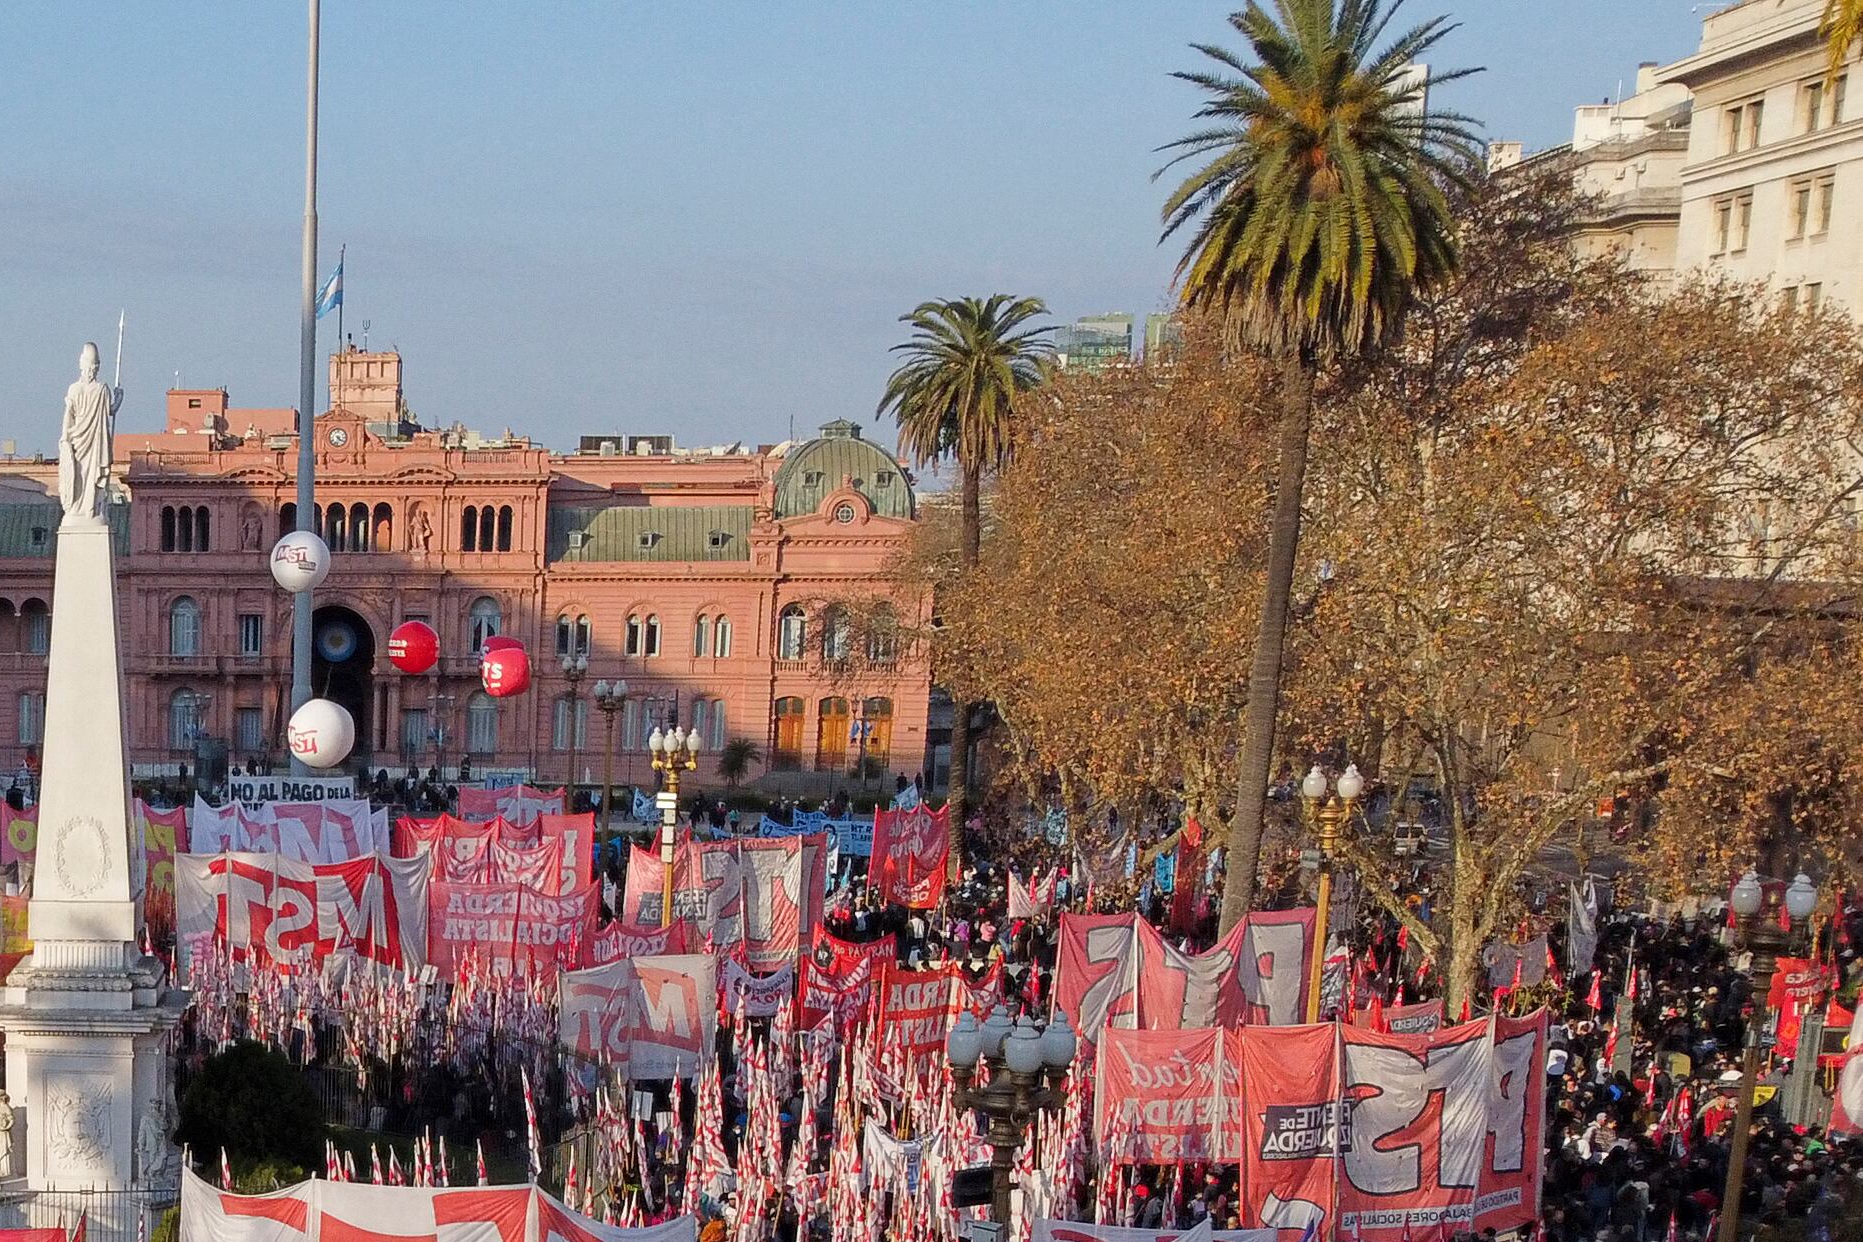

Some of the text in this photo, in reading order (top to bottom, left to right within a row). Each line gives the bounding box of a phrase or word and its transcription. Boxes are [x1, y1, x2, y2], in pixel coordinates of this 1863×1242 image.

[231, 784, 254, 801] NO
[258, 784, 278, 801] AL
[282, 782, 323, 802] PAGO
